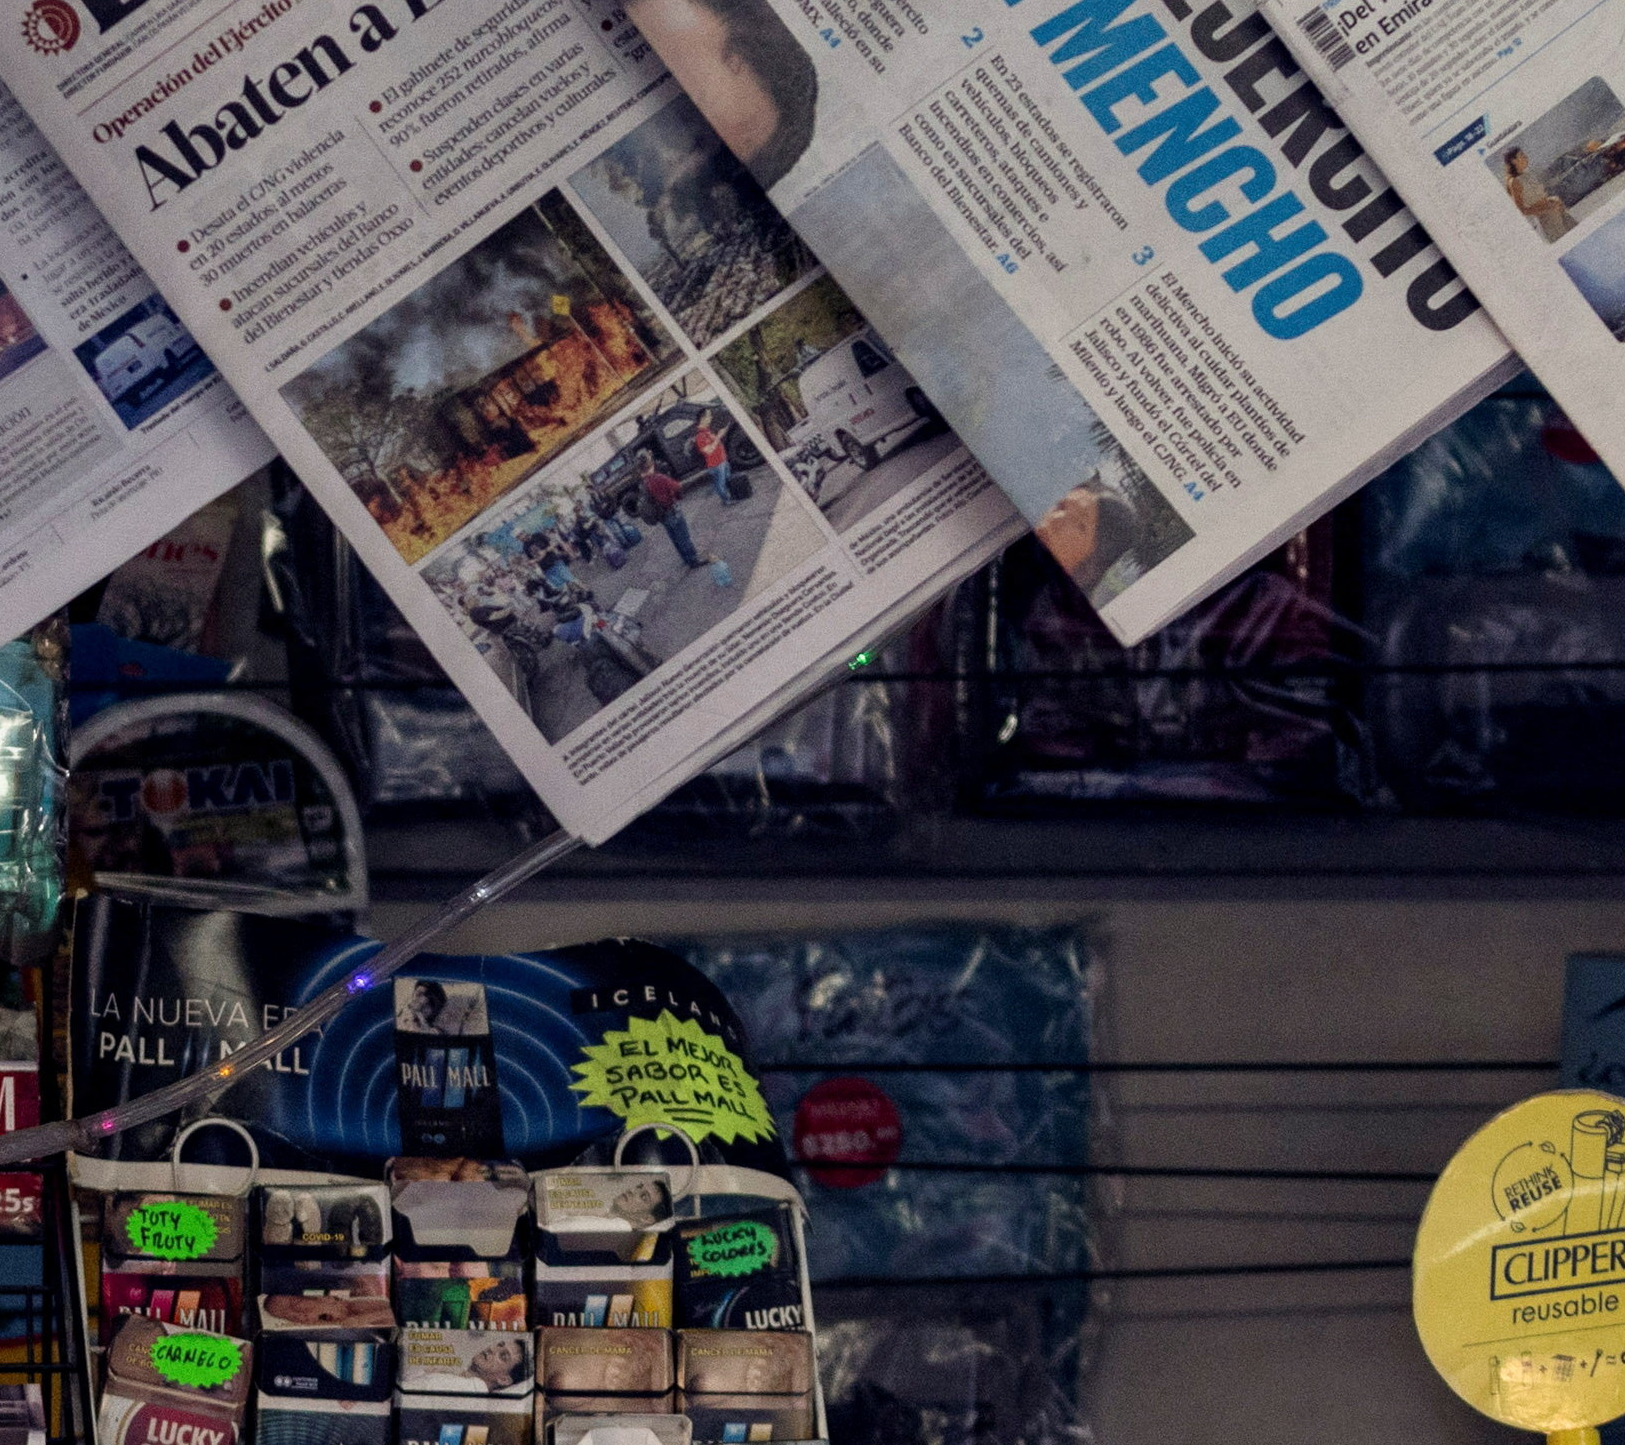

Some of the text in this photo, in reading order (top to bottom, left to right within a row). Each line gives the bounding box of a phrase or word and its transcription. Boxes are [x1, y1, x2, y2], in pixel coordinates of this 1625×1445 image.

[1356, 32, 1380, 54] en
[93, 69, 193, 143] Operación
[192, 43, 222, 73] del
[135, 36, 353, 210] Abaten
[346, 1, 399, 54] a
[90, 989, 250, 1029] LA NUEVA
[100, 1032, 174, 1067] PALL
[619, 1036, 739, 1079] EL MEJOR
[606, 1061, 746, 1099] SABOR ES
[612, 1086, 757, 1121] PALL MALL
[1502, 1164, 1556, 1199] RETHINK
[1510, 1177, 1562, 1213] REUSE
[1512, 1293, 1618, 1324] reusable
